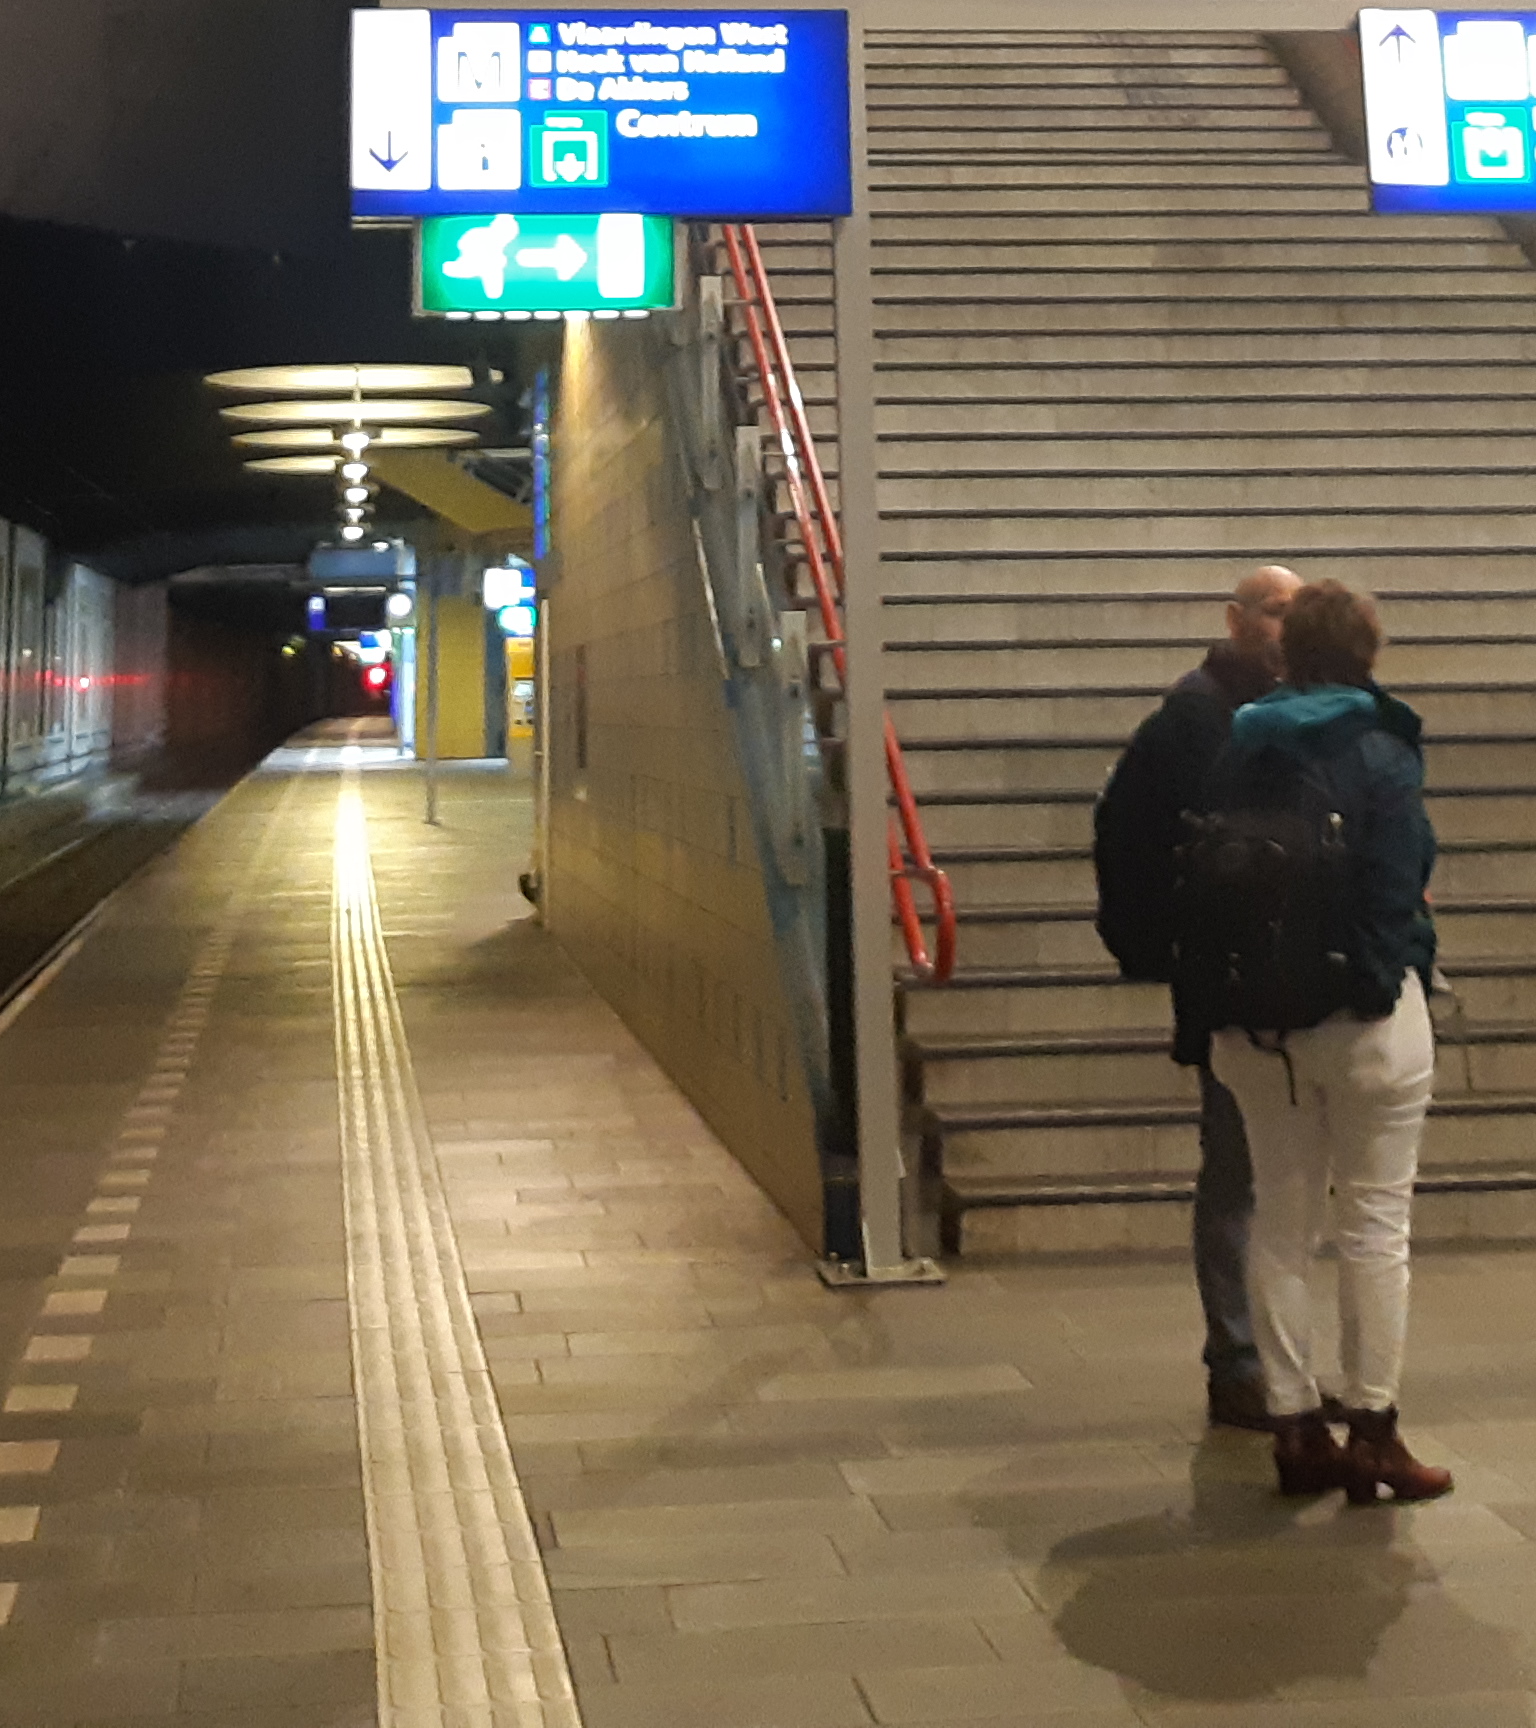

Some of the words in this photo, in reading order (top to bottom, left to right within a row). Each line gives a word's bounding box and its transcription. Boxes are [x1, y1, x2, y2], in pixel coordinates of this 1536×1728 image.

[557, 21, 717, 51] Vlaardingen
[719, 22, 789, 45] West
[556, 48, 626, 73] Hoek
[628, 53, 680, 73] van
[683, 48, 786, 73] Holland
[556, 76, 595, 101] De
[615, 108, 758, 138] Centrum
